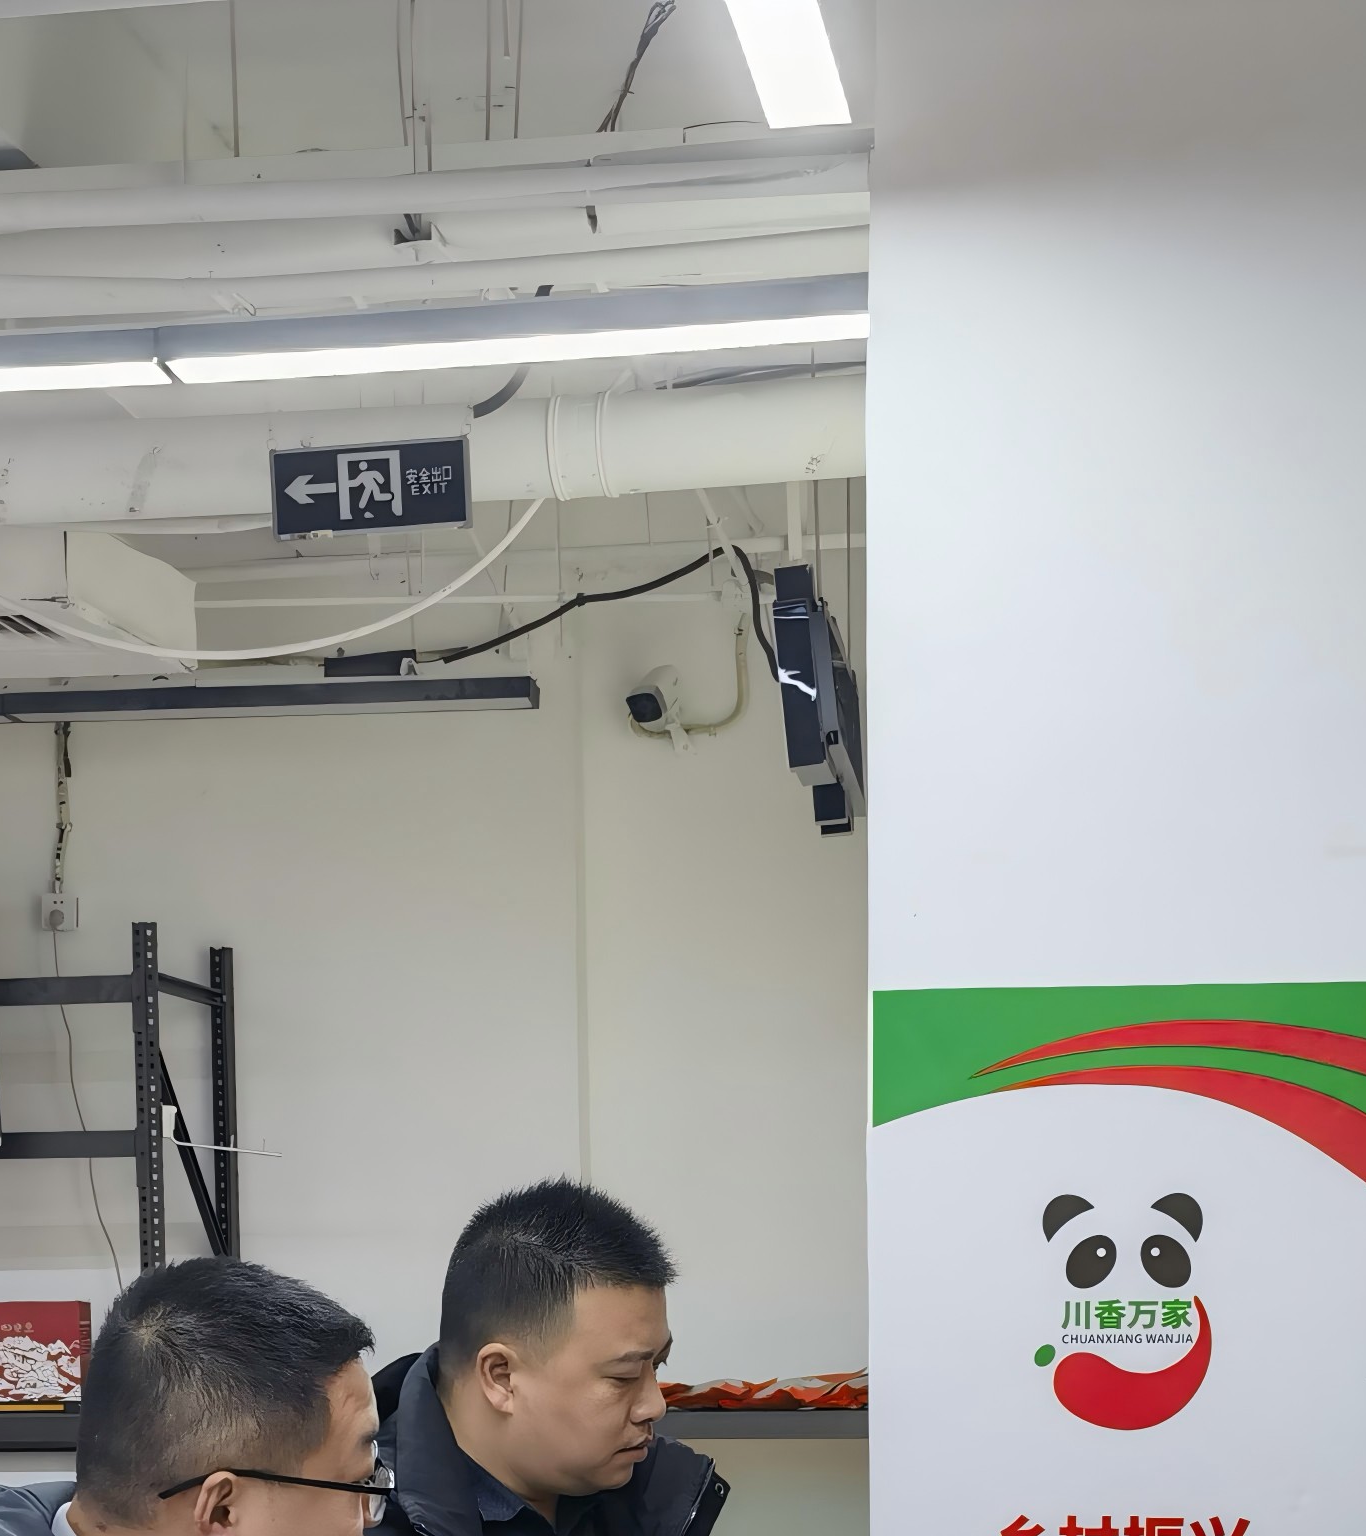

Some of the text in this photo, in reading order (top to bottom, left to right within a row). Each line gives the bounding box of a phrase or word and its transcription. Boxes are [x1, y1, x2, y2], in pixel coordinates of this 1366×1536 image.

[406, 466, 452, 484] 安全出口
[411, 482, 448, 495] EXIT
[1061, 1299, 1193, 1330] 川香万家
[1061, 1333, 1194, 1344] CHUANXIANG WANJIA
